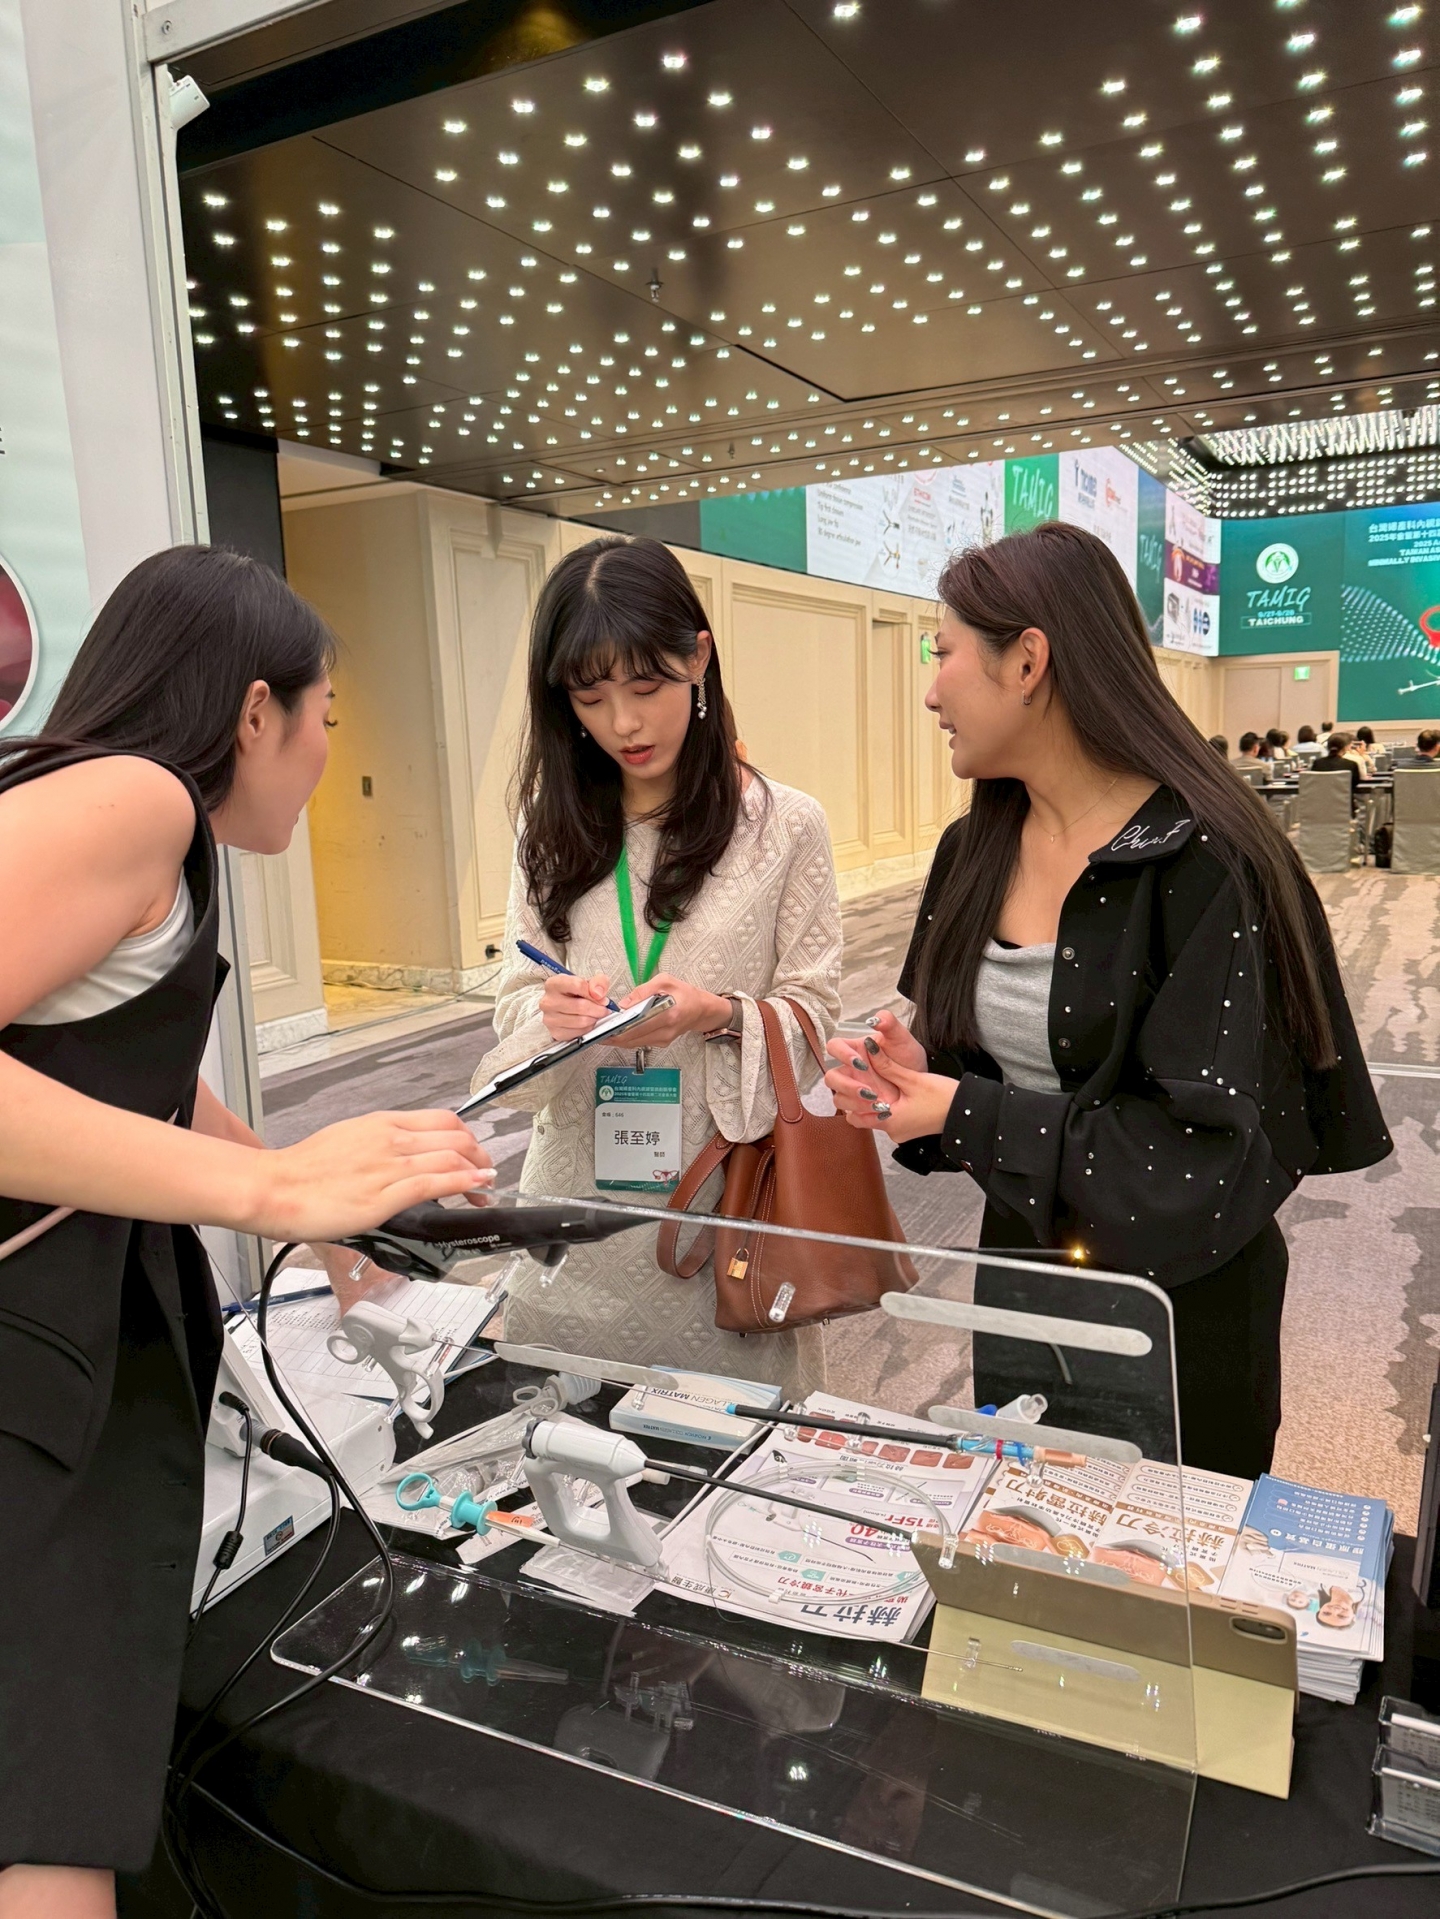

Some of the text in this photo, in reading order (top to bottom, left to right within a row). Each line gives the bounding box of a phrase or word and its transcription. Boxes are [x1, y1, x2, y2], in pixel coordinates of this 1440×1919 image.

[1012, 465, 1054, 518] TAMIG
[1246, 585, 1311, 612] TAMIG
[1248, 615, 1304, 627] TAICHUNG
[600, 1074, 628, 1086] TAMIG
[614, 1130, 660, 1146] 張至婷
[650, 1387, 690, 1399] MATRIX
[1005, 1478, 1108, 1526] 赫拉雷射刀
[884, 1514, 923, 1527] 15Fr
[1115, 1512, 1225, 1550] 赫拉冷刀
[1284, 1532, 1364, 1554] 膠原蛋白基質
